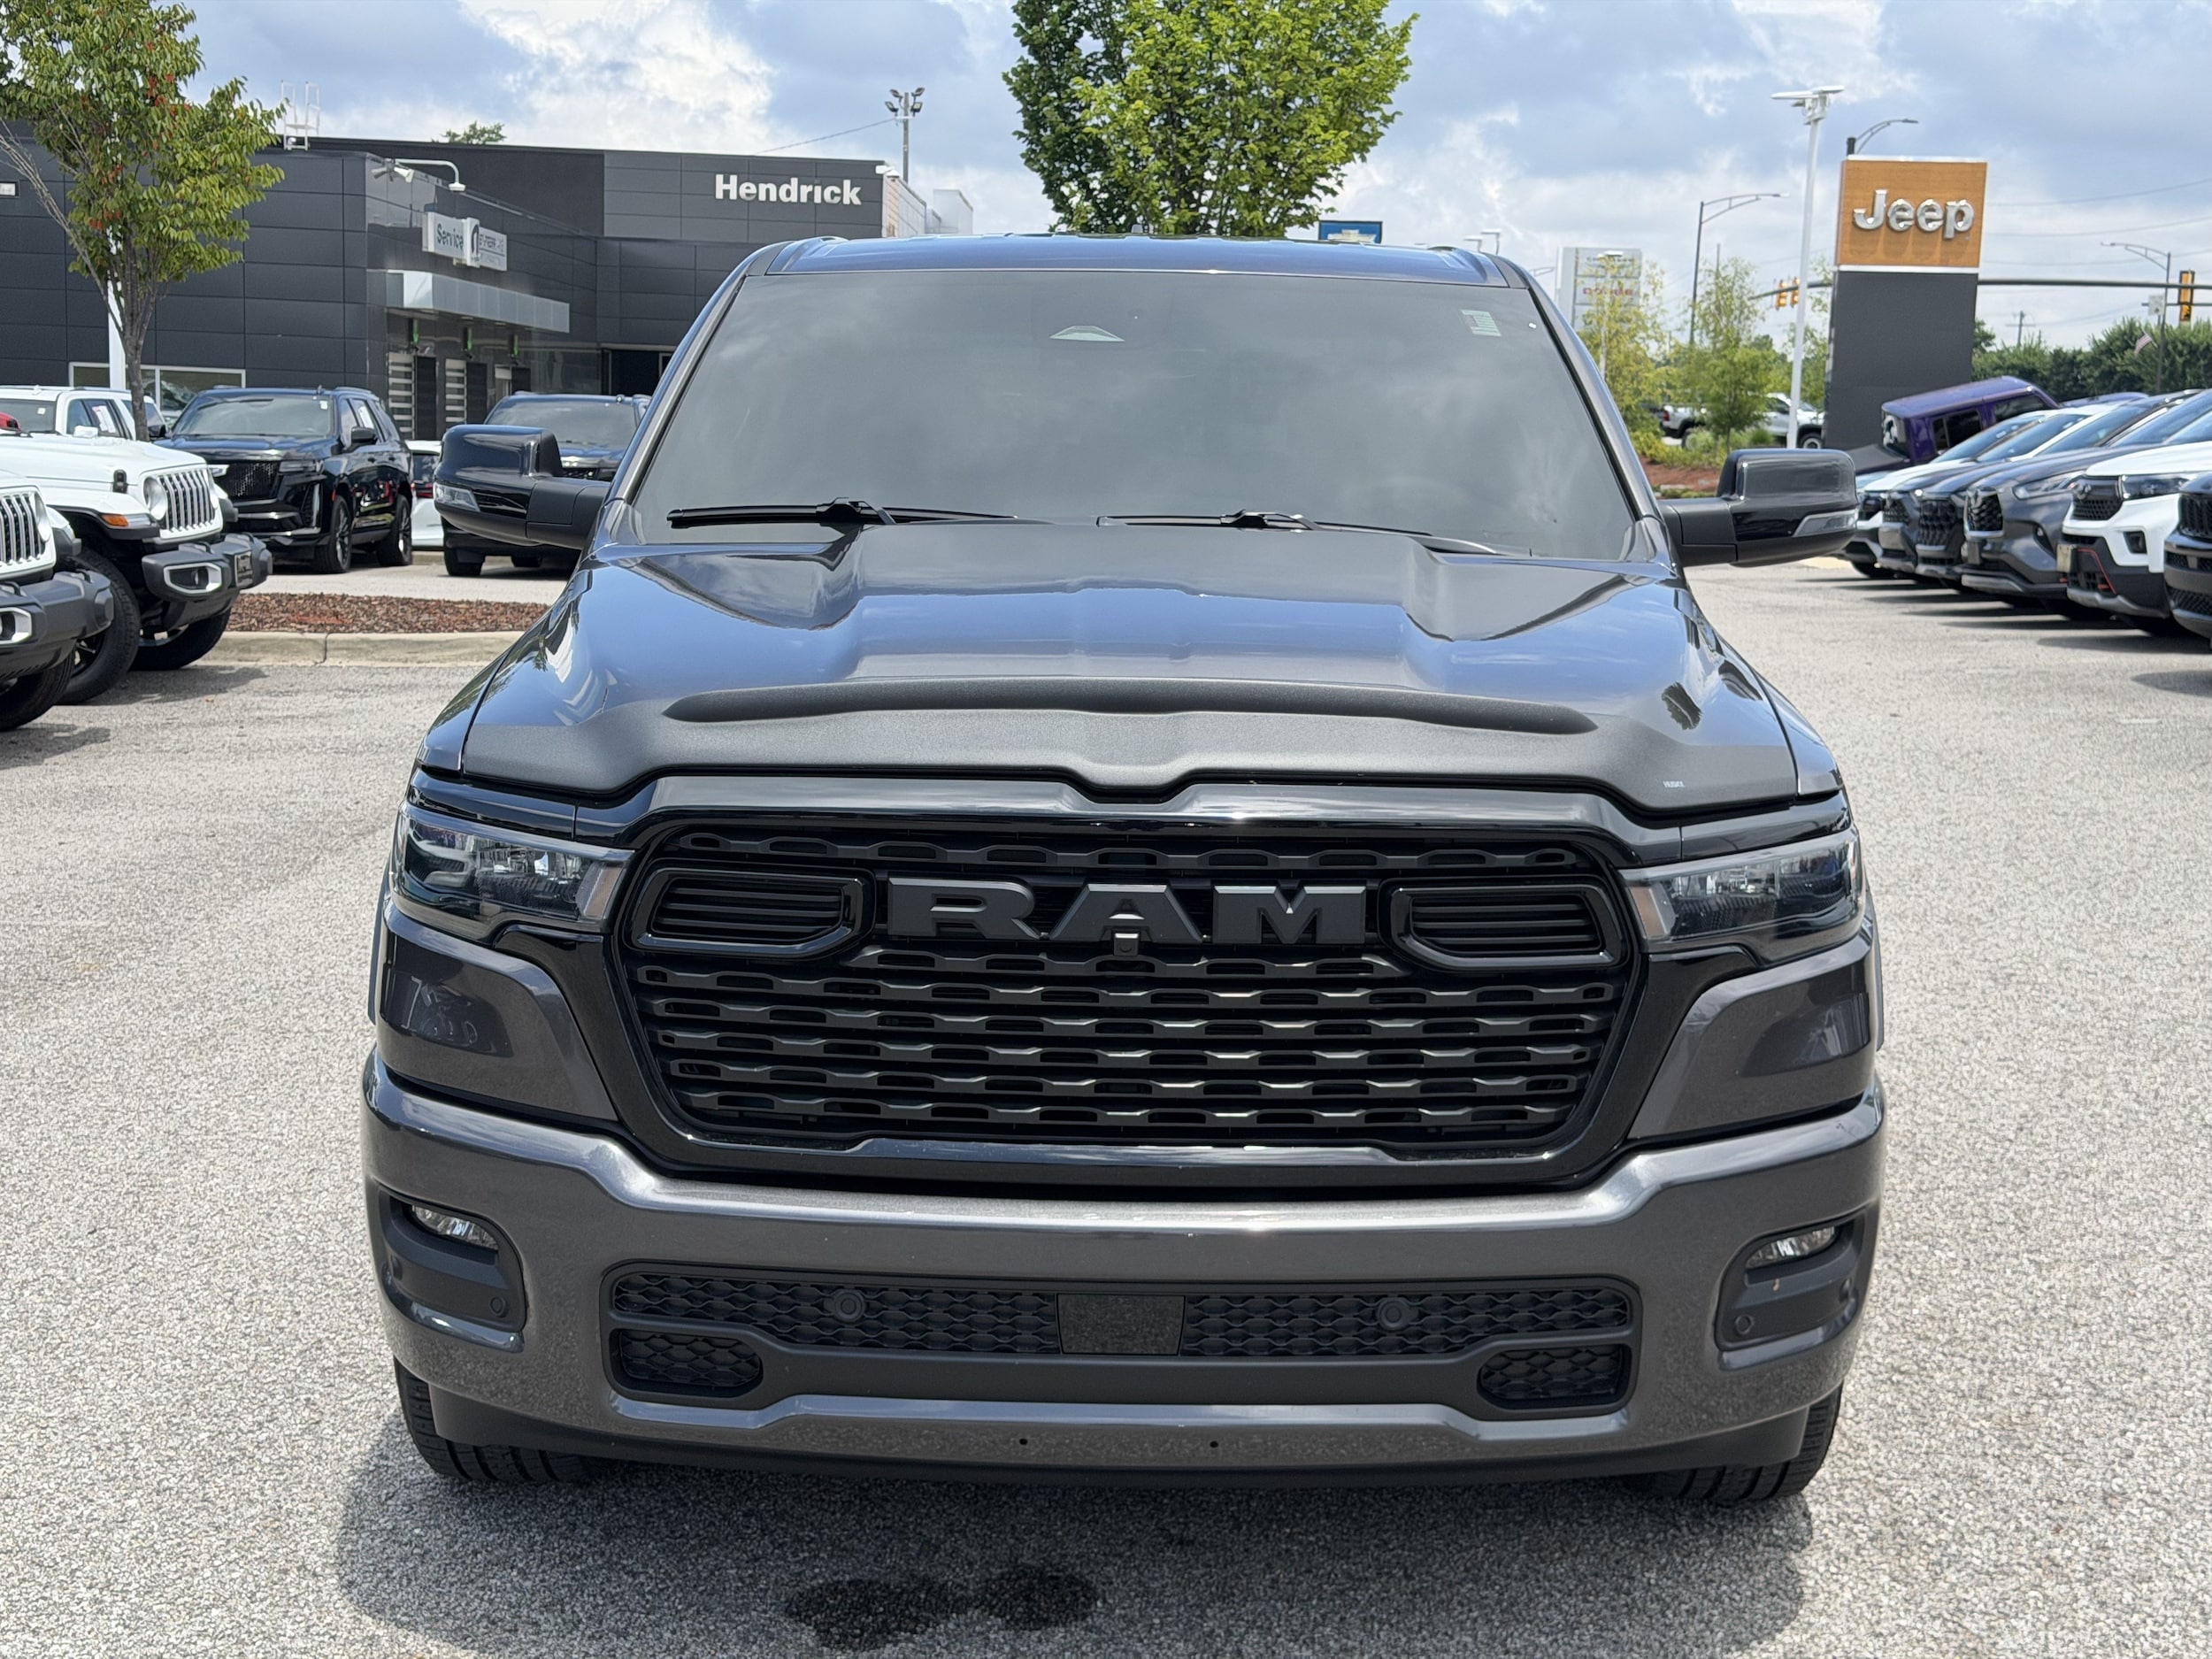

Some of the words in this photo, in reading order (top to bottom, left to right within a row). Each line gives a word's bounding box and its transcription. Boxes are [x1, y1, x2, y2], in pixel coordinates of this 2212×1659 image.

[715, 173, 862, 205] Hendrick
[1854, 189, 1975, 240] Jeep
[436, 223, 465, 249] Service
[887, 877, 1367, 944] RAM
